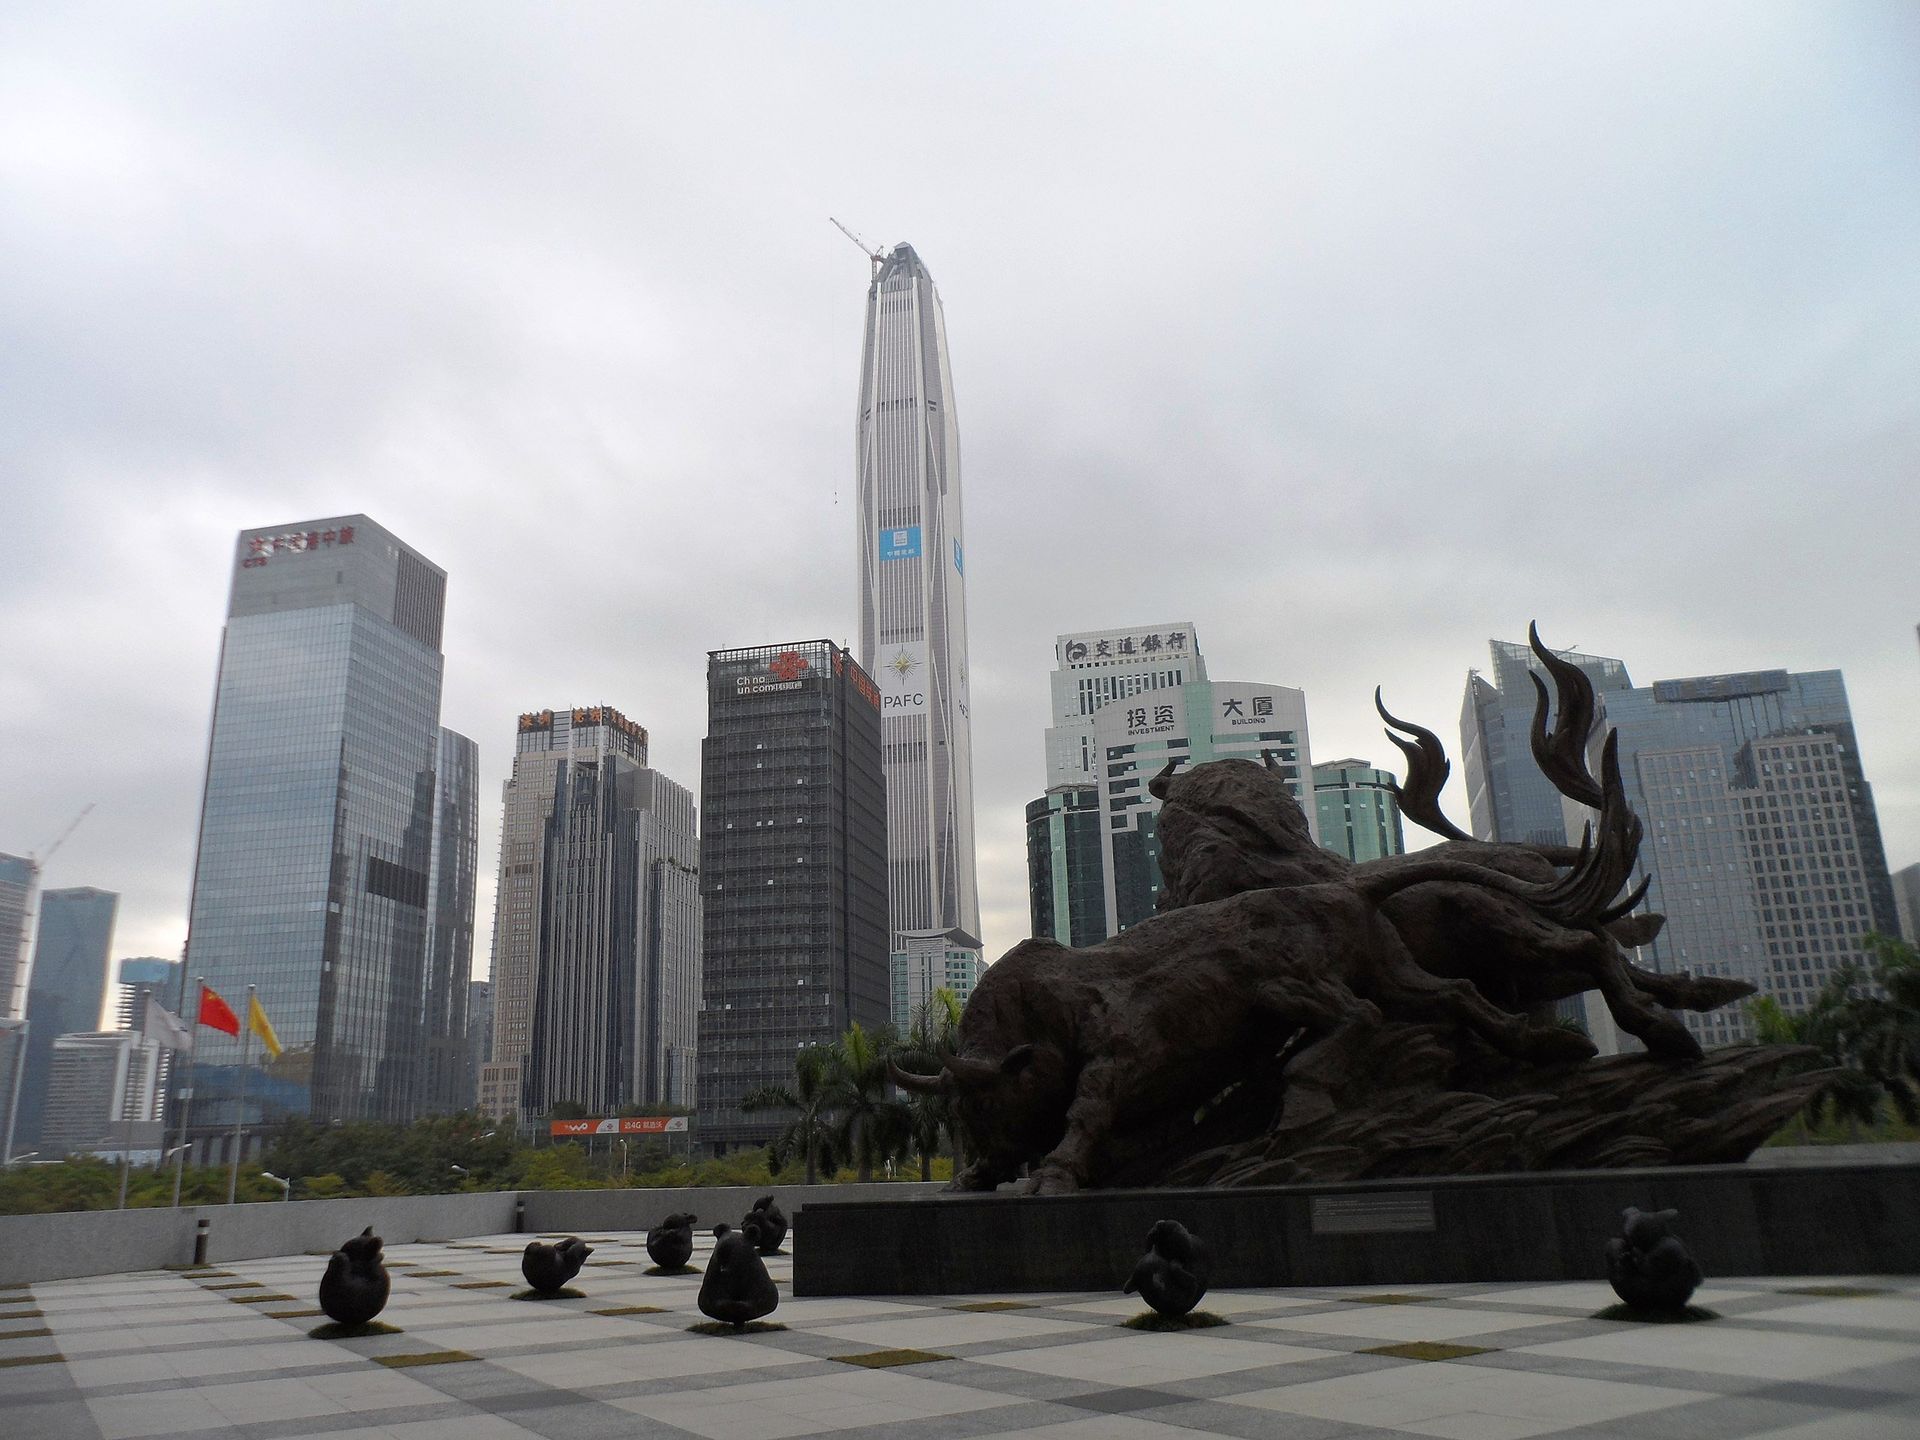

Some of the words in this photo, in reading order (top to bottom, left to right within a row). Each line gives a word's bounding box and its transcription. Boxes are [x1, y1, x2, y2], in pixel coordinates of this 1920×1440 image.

[883, 693, 924, 709] PAFC
[1127, 705, 1174, 728] 投资
[1222, 696, 1273, 718] 大厦
[1128, 725, 1174, 736] INVESTMENT
[1231, 717, 1266, 726] BUILDING
